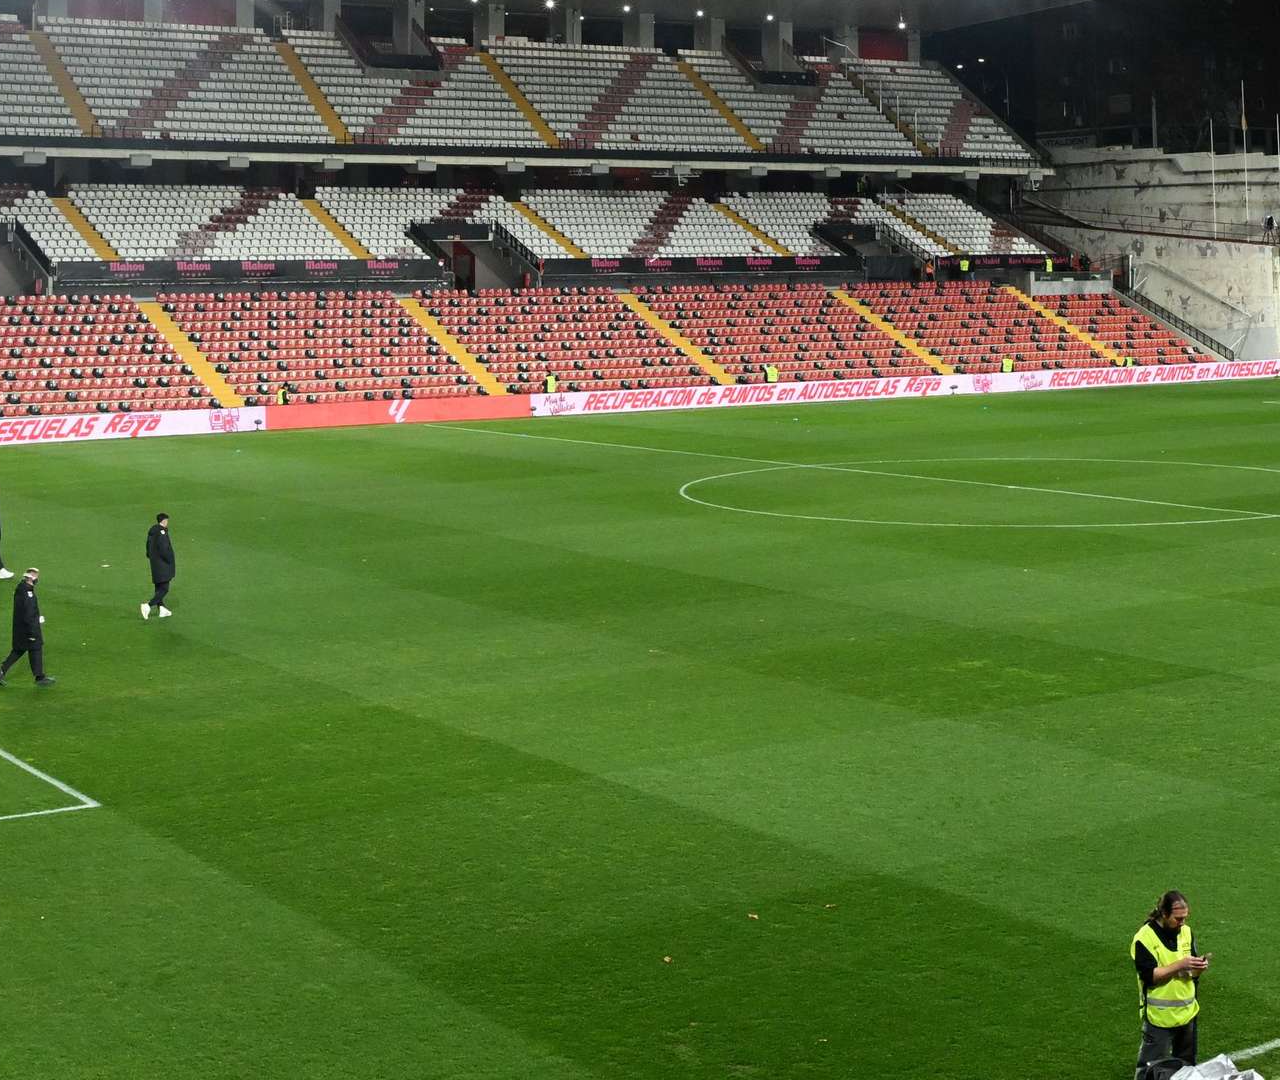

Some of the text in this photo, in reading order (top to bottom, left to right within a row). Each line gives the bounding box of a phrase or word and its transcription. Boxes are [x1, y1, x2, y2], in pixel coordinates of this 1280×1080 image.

[109, 262, 144, 271] Mahou
[176, 261, 211, 271] Mahou
[241, 261, 275, 270] Mahou
[305, 260, 338, 270] Mahou
[367, 260, 399, 269] Mahou
[1136, 368, 1150, 383] de
[1153, 365, 1195, 382] PUNTOS
[1197, 368, 1210, 379] en
[696, 388, 716, 404] de
[718, 385, 777, 403] PUNTOS
[776, 387, 796, 401] en
[797, 378, 900, 400] AUTOESCUELAS
[903, 376, 942, 396] Rayo
[103, 413, 161, 437] Rayo
